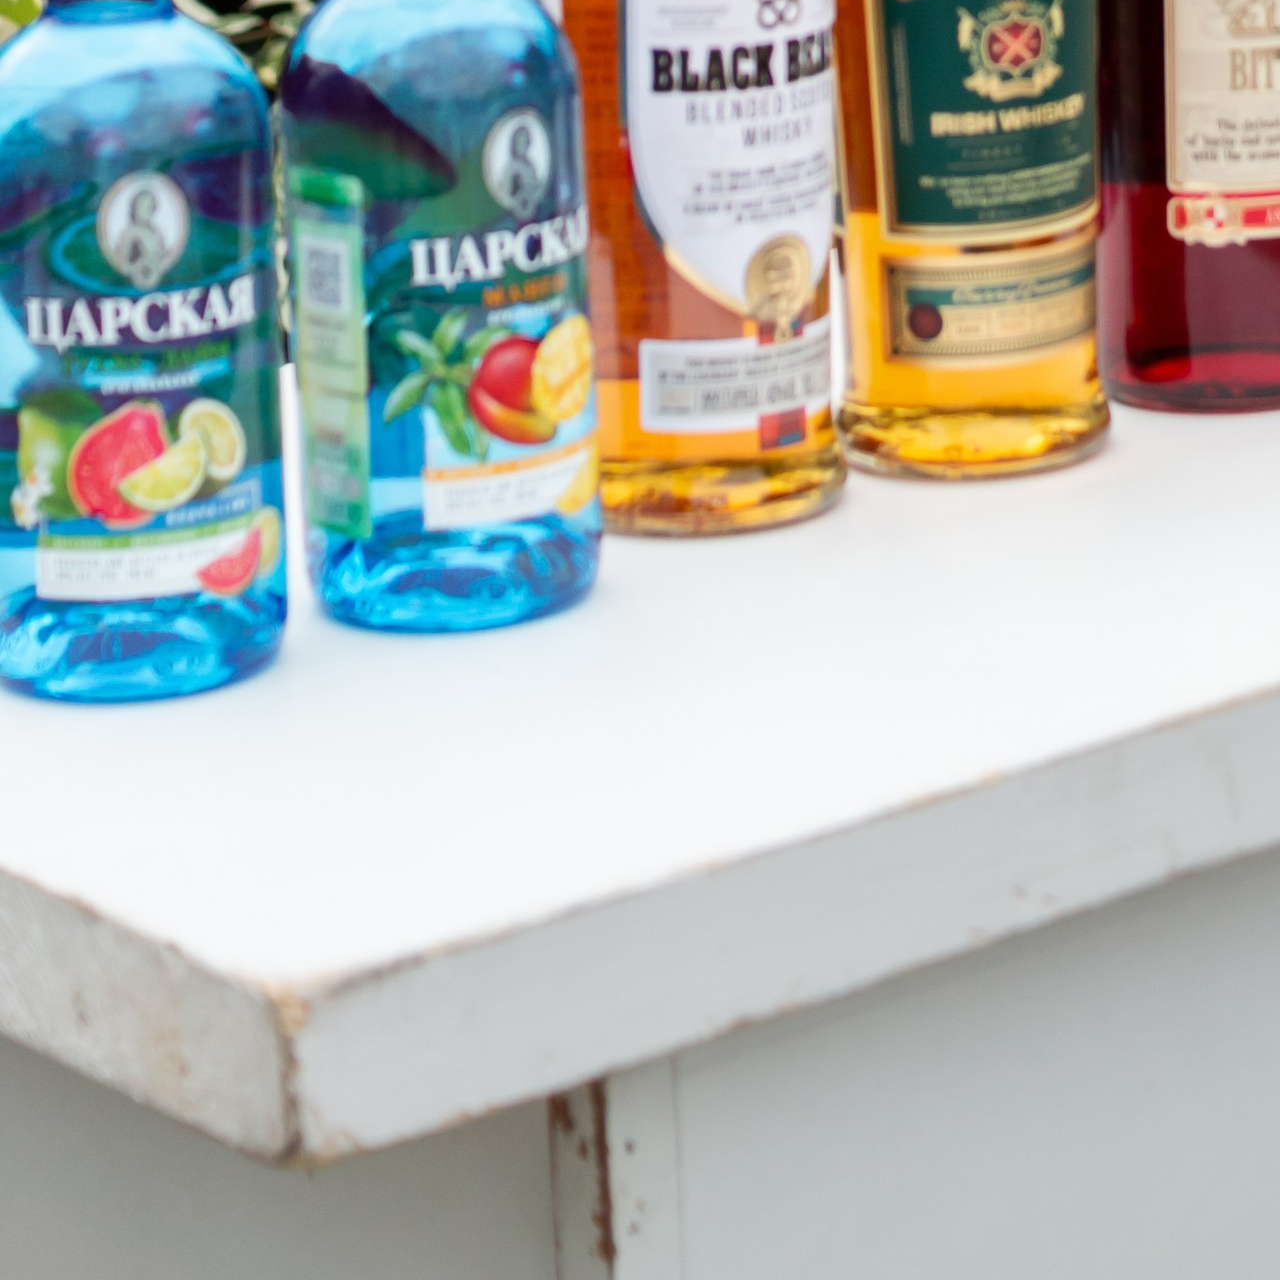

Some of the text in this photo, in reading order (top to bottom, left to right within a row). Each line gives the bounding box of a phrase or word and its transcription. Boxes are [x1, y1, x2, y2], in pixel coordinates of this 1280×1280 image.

[651, 43, 774, 93] BLACK
[930, 110, 998, 138] IRISH
[24, 274, 257, 354] ЦАРСКАЯ
